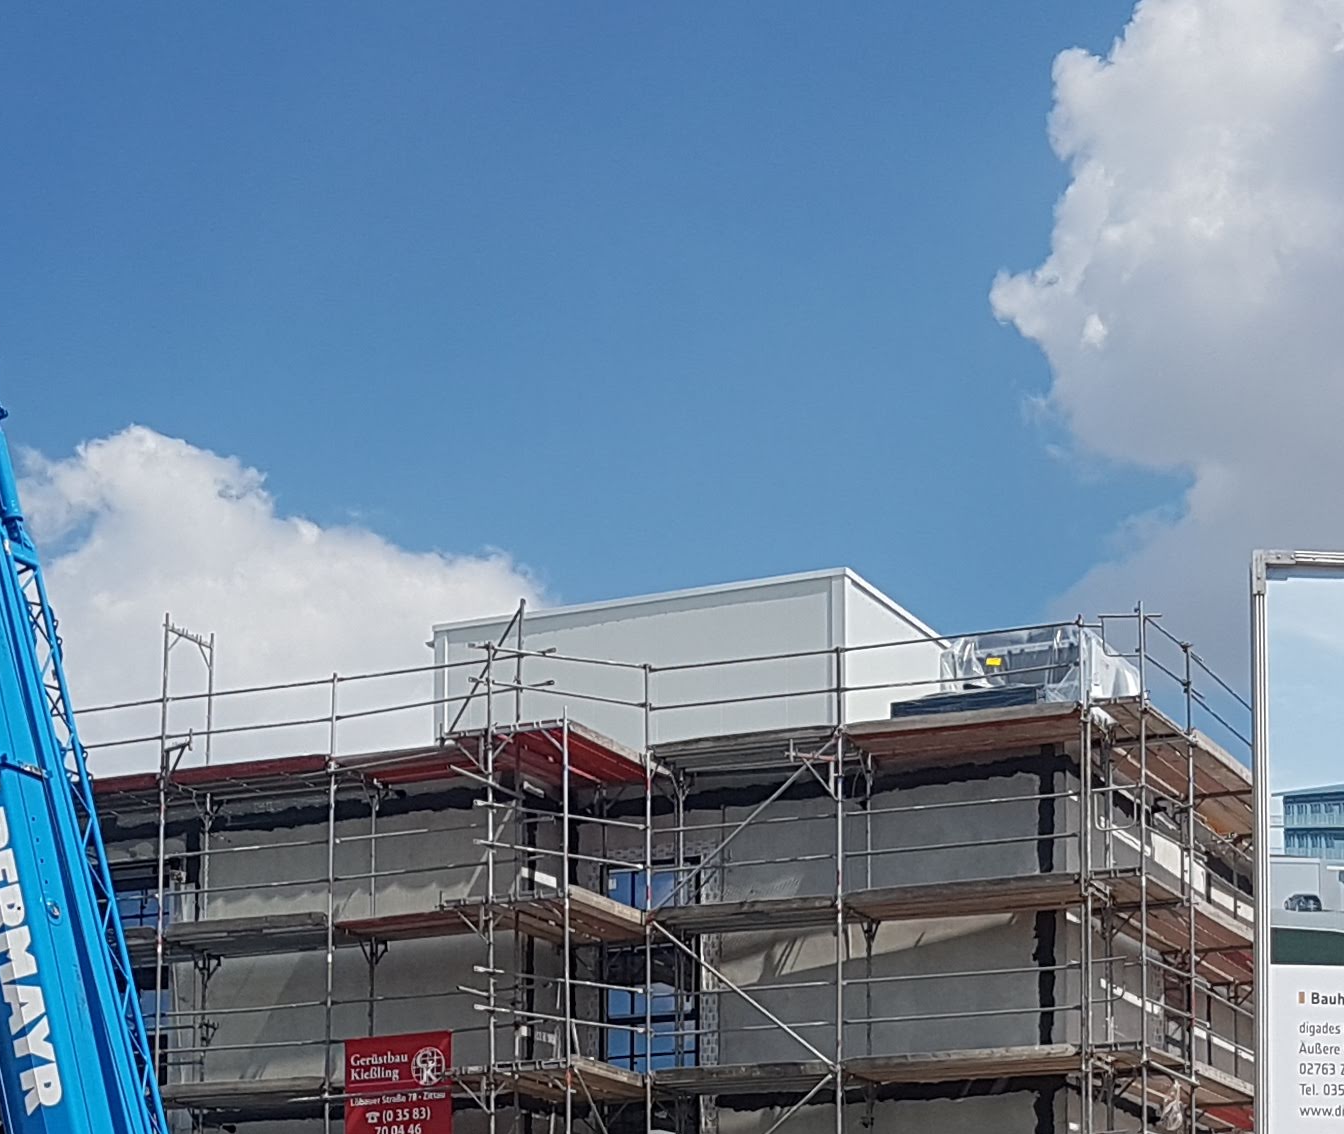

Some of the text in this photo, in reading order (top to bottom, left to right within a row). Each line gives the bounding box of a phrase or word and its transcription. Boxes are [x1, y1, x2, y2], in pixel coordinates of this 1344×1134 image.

[1299, 1022, 1341, 1037] digades
[1299, 1040, 1341, 1055] Äußere
[350, 1051, 409, 1067] Gerüstbau
[350, 1067, 400, 1082] Kießling
[1299, 1062, 1336, 1075] 02763
[1299, 1083, 1319, 1096] Tel.
[382, 1106, 431, 1123] (0 35 83)
